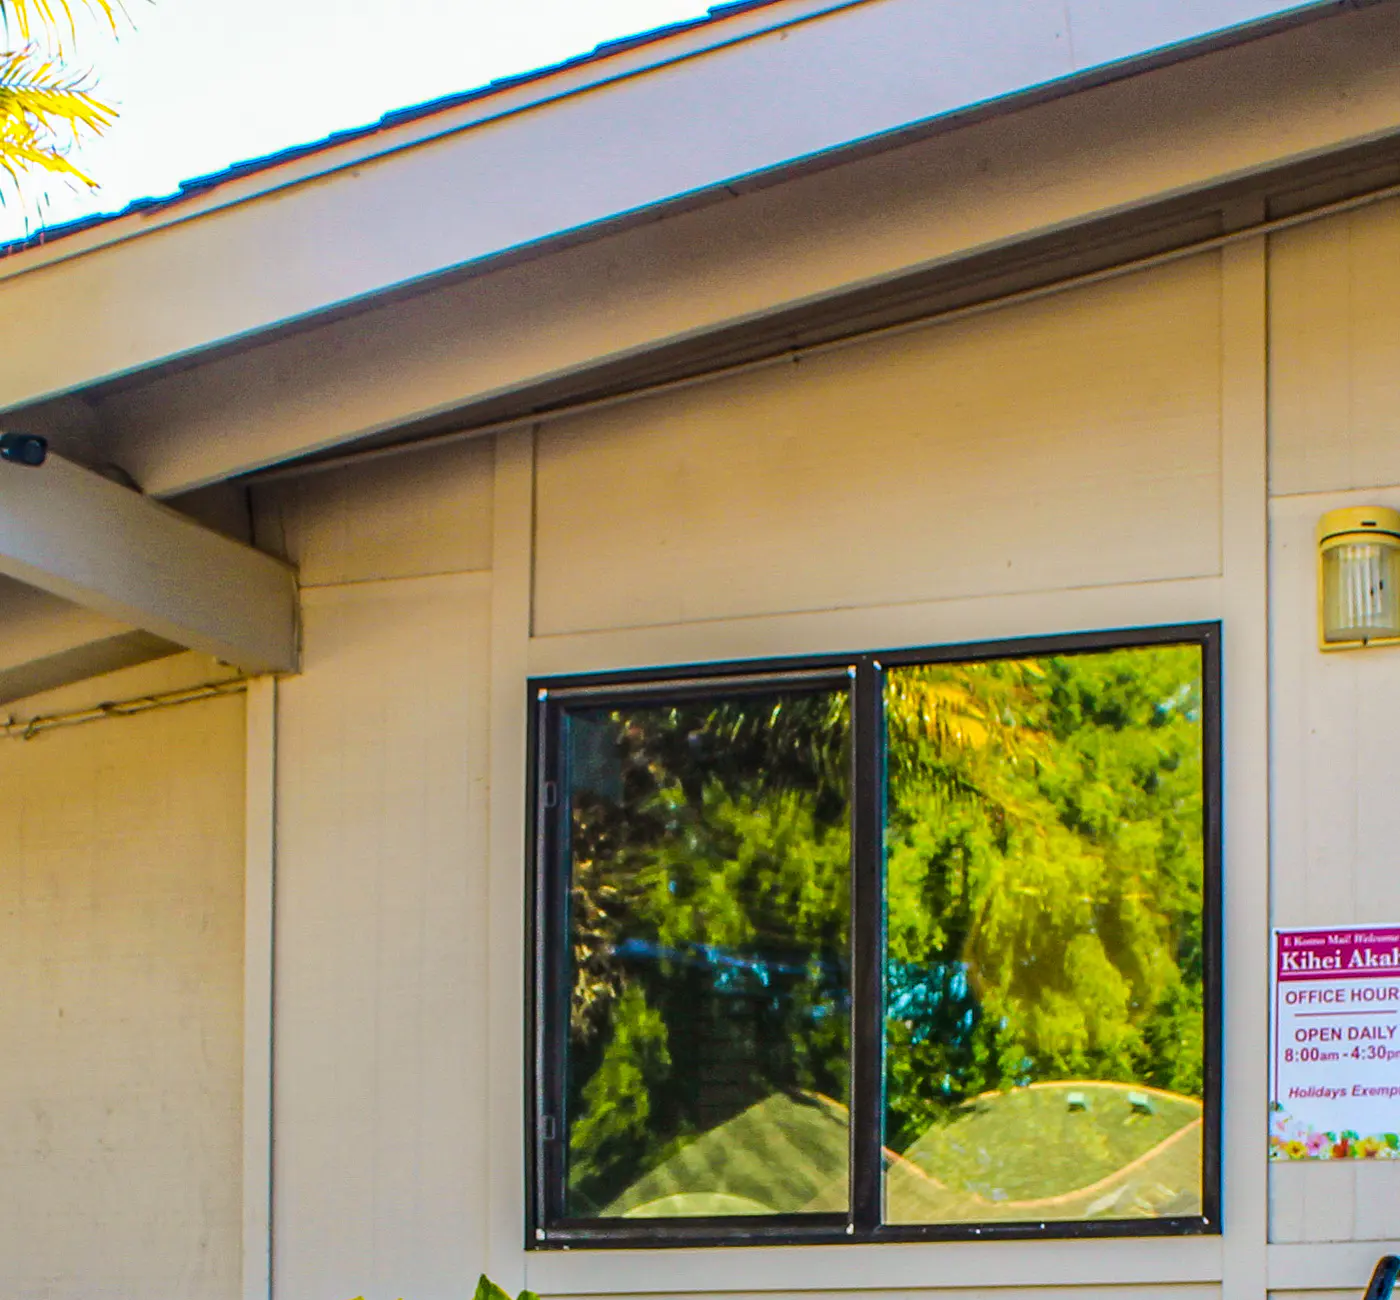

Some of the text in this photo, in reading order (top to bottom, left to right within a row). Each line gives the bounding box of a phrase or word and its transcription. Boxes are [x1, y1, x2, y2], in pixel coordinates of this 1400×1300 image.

[1281, 949, 1342, 971] Kihei
[1285, 988, 1345, 1005] OFFICE
[1294, 1025, 1397, 1042] OPEN DAILY
[1284, 1047, 1340, 1062] 8:00am
[1288, 1085, 1347, 1099] Holidays
